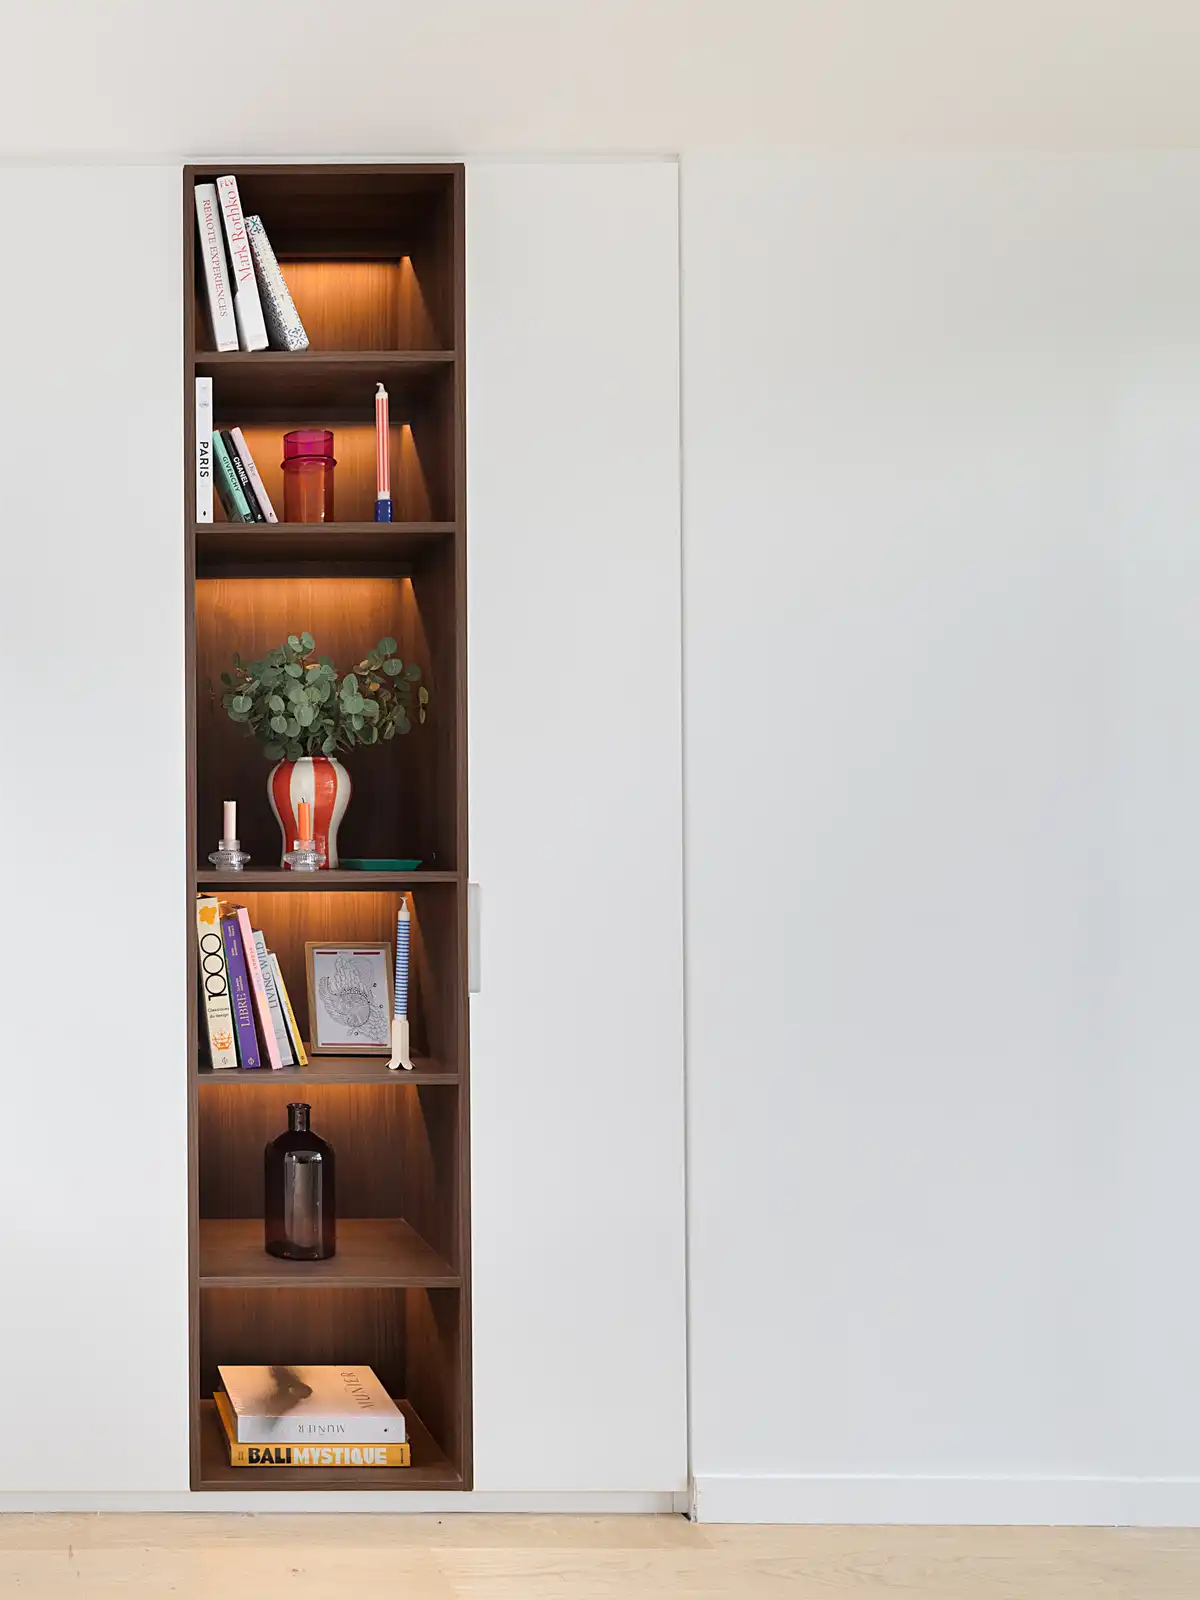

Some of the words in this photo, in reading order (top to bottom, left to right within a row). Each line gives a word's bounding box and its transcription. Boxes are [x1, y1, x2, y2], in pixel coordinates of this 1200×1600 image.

[225, 190, 244, 244] Rothko
[203, 199, 217, 244] REMOTE
[210, 246, 227, 317] EXPERIENCES
[233, 245, 253, 282] Mark
[199, 441, 209, 478] PARIS
[223, 456, 240, 492] GIVENCHY
[233, 456, 249, 486] CHANEL
[256, 941, 270, 970] WILD
[263, 971, 278, 1009] LIVING
[236, 993, 250, 1027] LIBRE
[248, 1447, 292, 1464] BALI
[293, 1447, 387, 1464] MYSTIQUE
